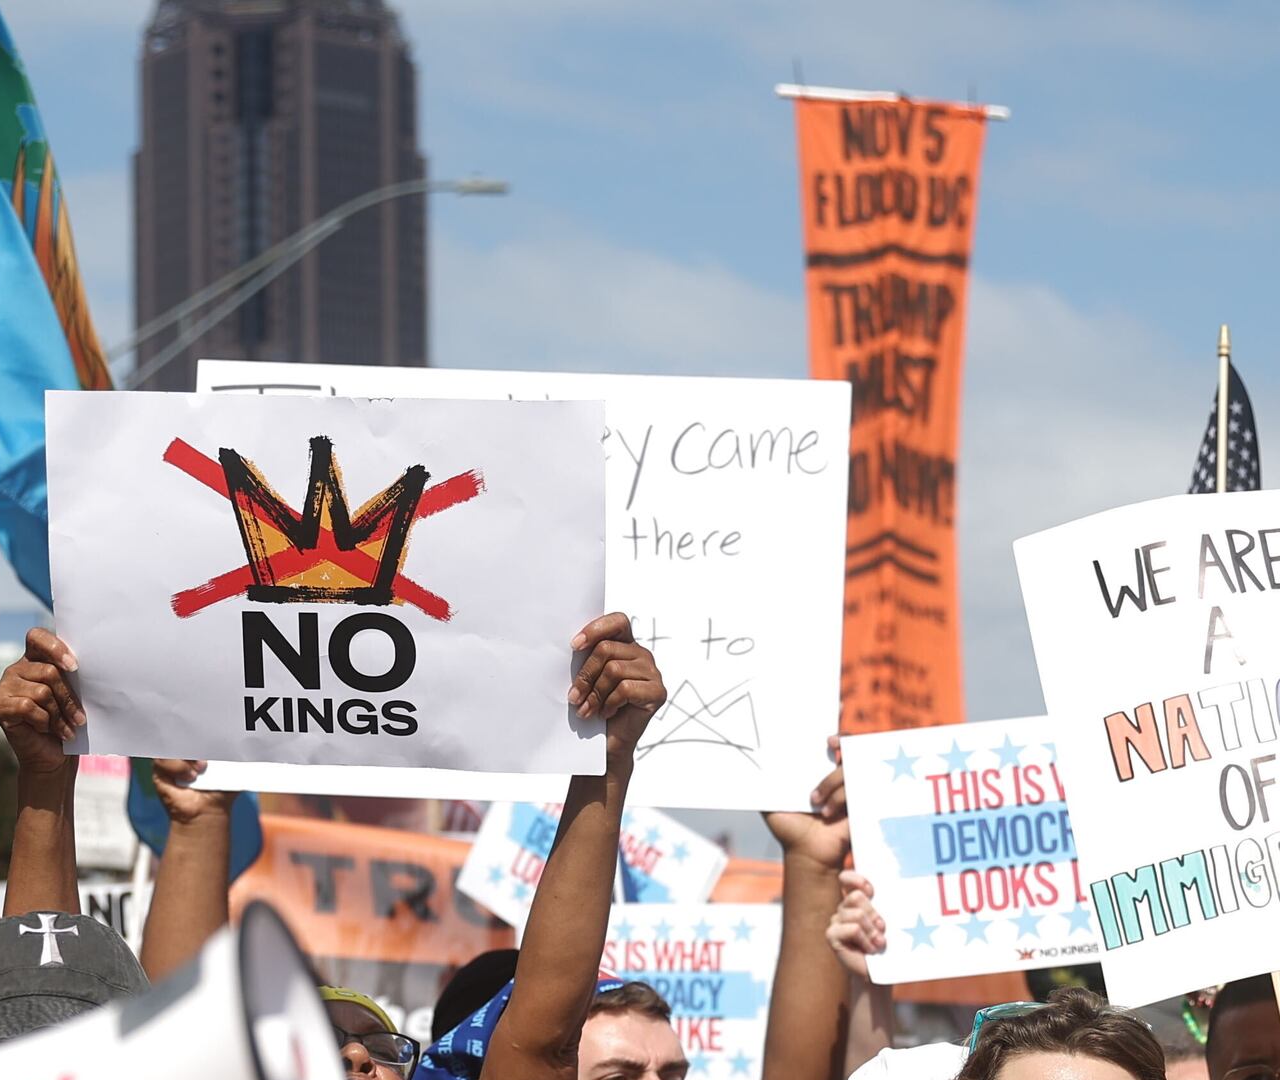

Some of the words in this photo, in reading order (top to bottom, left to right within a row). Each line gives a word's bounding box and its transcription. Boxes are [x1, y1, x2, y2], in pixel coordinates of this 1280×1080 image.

[670, 421, 828, 475] came
[623, 516, 742, 561] there
[1092, 540, 1176, 618] WE
[241, 611, 417, 692] NO
[700, 617, 756, 660] to
[1203, 605, 1247, 674] A
[245, 697, 418, 736] KINGS
[925, 769, 1004, 815] THIS
[1013, 763, 1045, 807] IS
[1219, 753, 1276, 831] OF
[936, 860, 1058, 916] LOOKS
[625, 940, 646, 973] IS
[653, 939, 726, 973] WHAT
